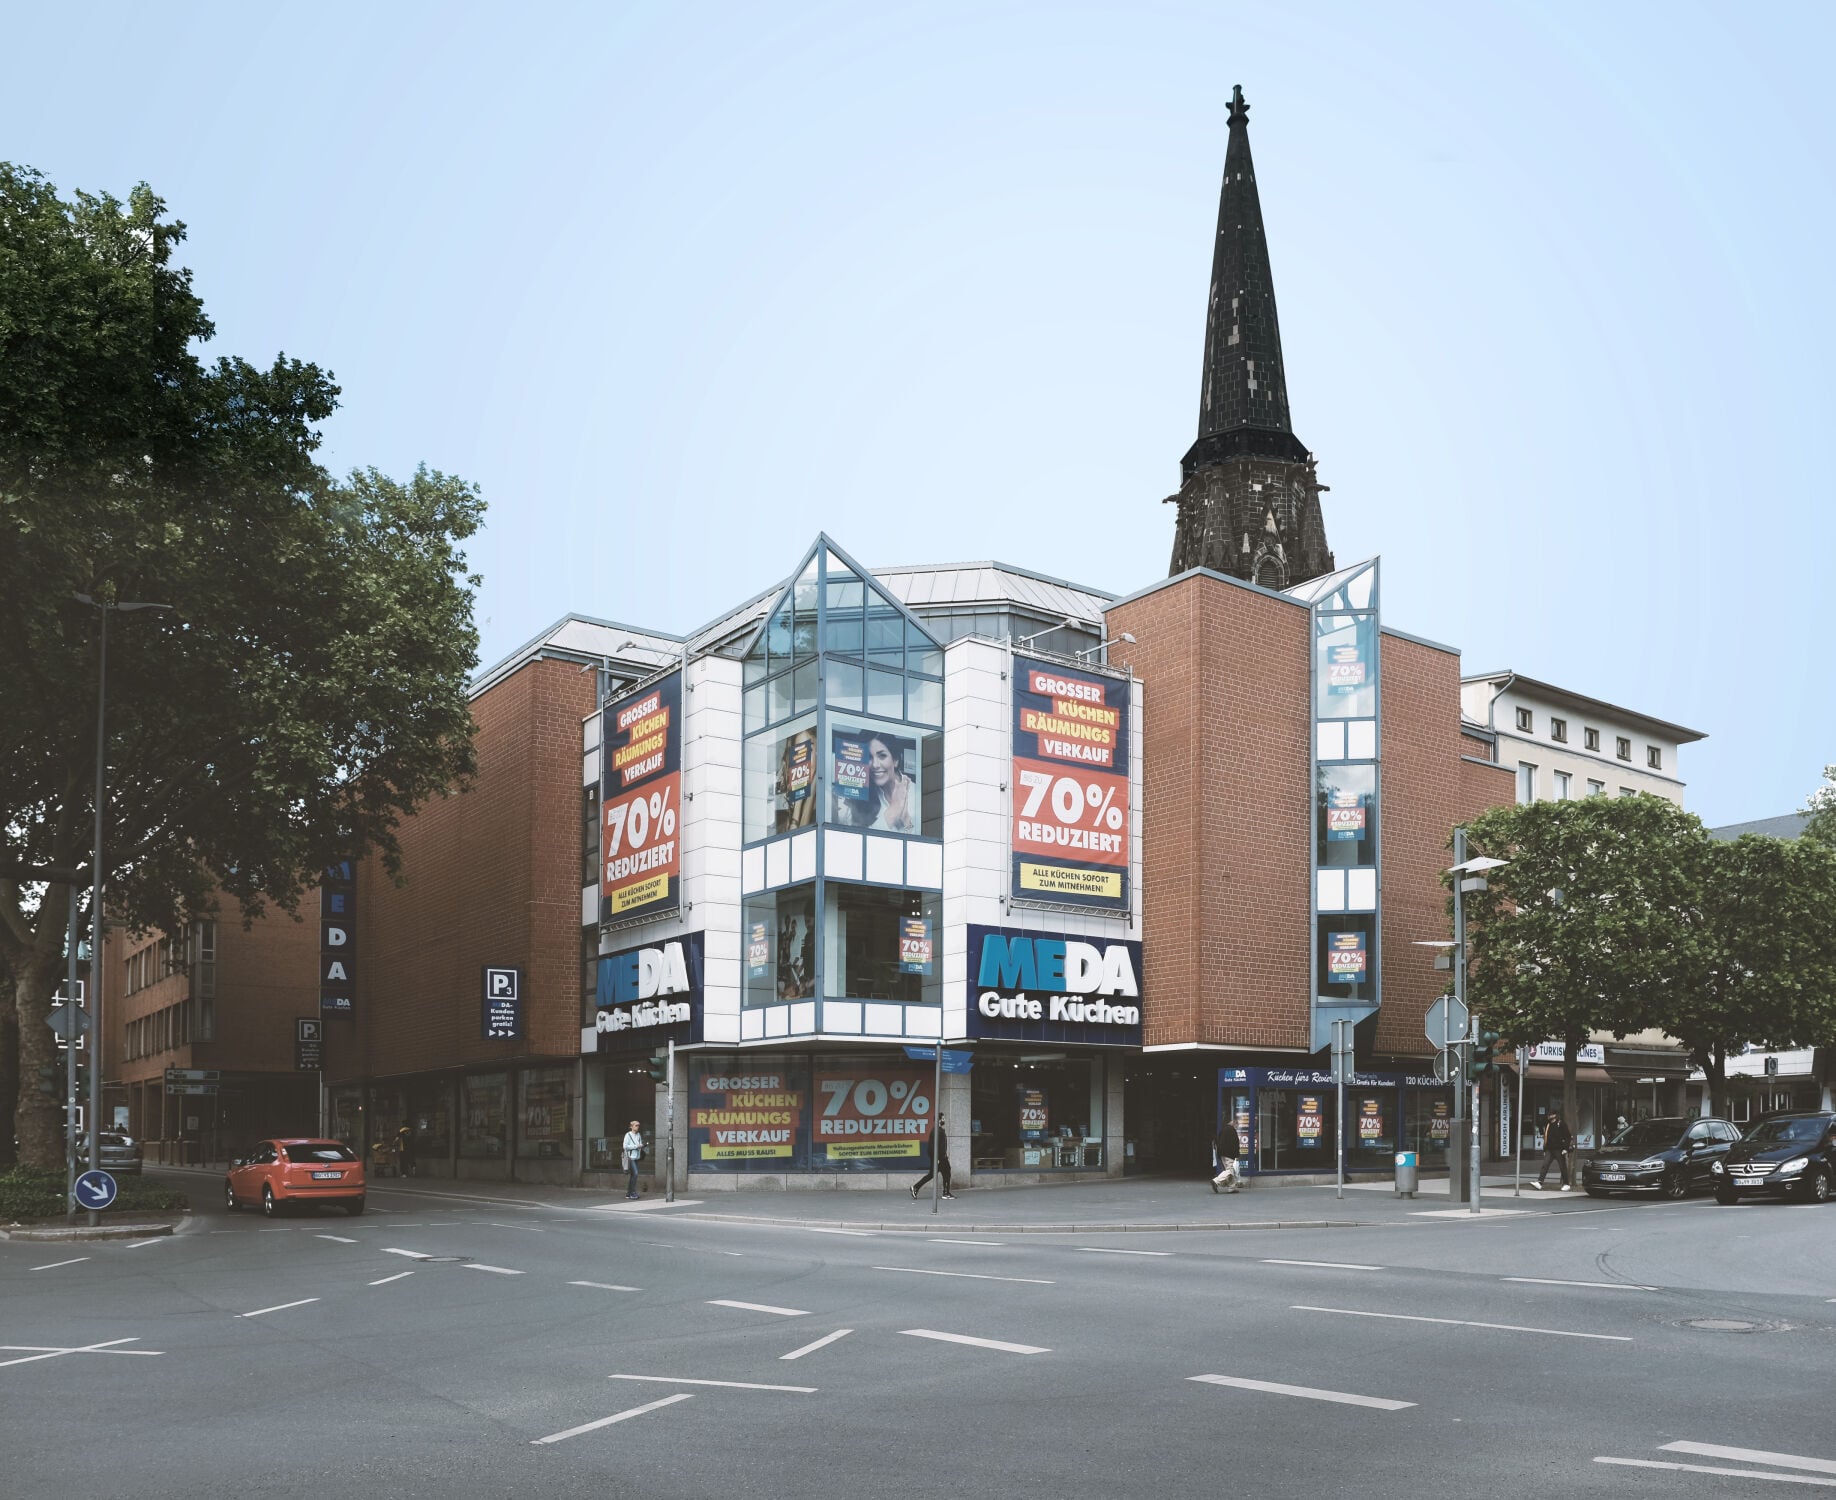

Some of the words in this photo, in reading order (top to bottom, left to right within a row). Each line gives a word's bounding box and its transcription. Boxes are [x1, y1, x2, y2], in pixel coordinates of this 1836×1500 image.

[1331, 665, 1362, 676] 70%
[1035, 676, 1101, 703] GROSSER
[620, 696, 658, 728] GROSSER
[1057, 699, 1115, 726] KÜCHEN
[632, 711, 667, 740] KÜCHEN
[1026, 711, 1111, 744] RÄUMUNGS
[615, 732, 663, 767] RÄUMUNGS
[1043, 738, 1110, 763] VERKAUF
[624, 752, 663, 782] VERKAUF
[791, 763, 810, 781] 70%
[837, 762, 867, 778] 70%
[1020, 769, 1123, 830] 70%
[607, 785, 676, 858] 70%
[1331, 810, 1362, 822] 70%
[1018, 820, 1122, 853] REDUZIERT
[606, 840, 675, 882] REDUZIERT
[645, 878, 662, 891] SOFORT
[1032, 868, 1049, 878] ALLE
[1050, 869, 1081, 881] KÜCHEN
[1082, 873, 1110, 884] SOFORT
[1039, 879, 1056, 888] ZUM
[1057, 881, 1104, 893] MITNEHMEN!
[750, 943, 767, 957] 70%
[902, 939, 930, 953] 70%
[977, 933, 1139, 997] MEDA
[1331, 952, 1362, 963] 70%
[596, 941, 690, 1007] MEDA
[596, 1007, 632, 1034] Gute
[631, 999, 691, 1029] Küchen
[978, 991, 1043, 1020] Gute
[1049, 995, 1140, 1026] Küchen
[706, 1076, 780, 1090] GROSSER
[1267, 1070, 1293, 1082] Küchen
[1294, 1072, 1309, 1085] fürs
[1405, 1076, 1416, 1085] 120
[732, 1090, 798, 1108] KÜCHEN
[821, 1079, 930, 1117] 70%
[697, 1110, 792, 1125] RÄUMUNGS
[1022, 1108, 1046, 1119] 70%
[1299, 1116, 1320, 1127] 70%
[820, 1119, 929, 1135] REDUZIERT
[1360, 1118, 1380, 1128] 70%
[1432, 1119, 1449, 1129] 70%
[716, 1129, 791, 1145] VERKAUF
